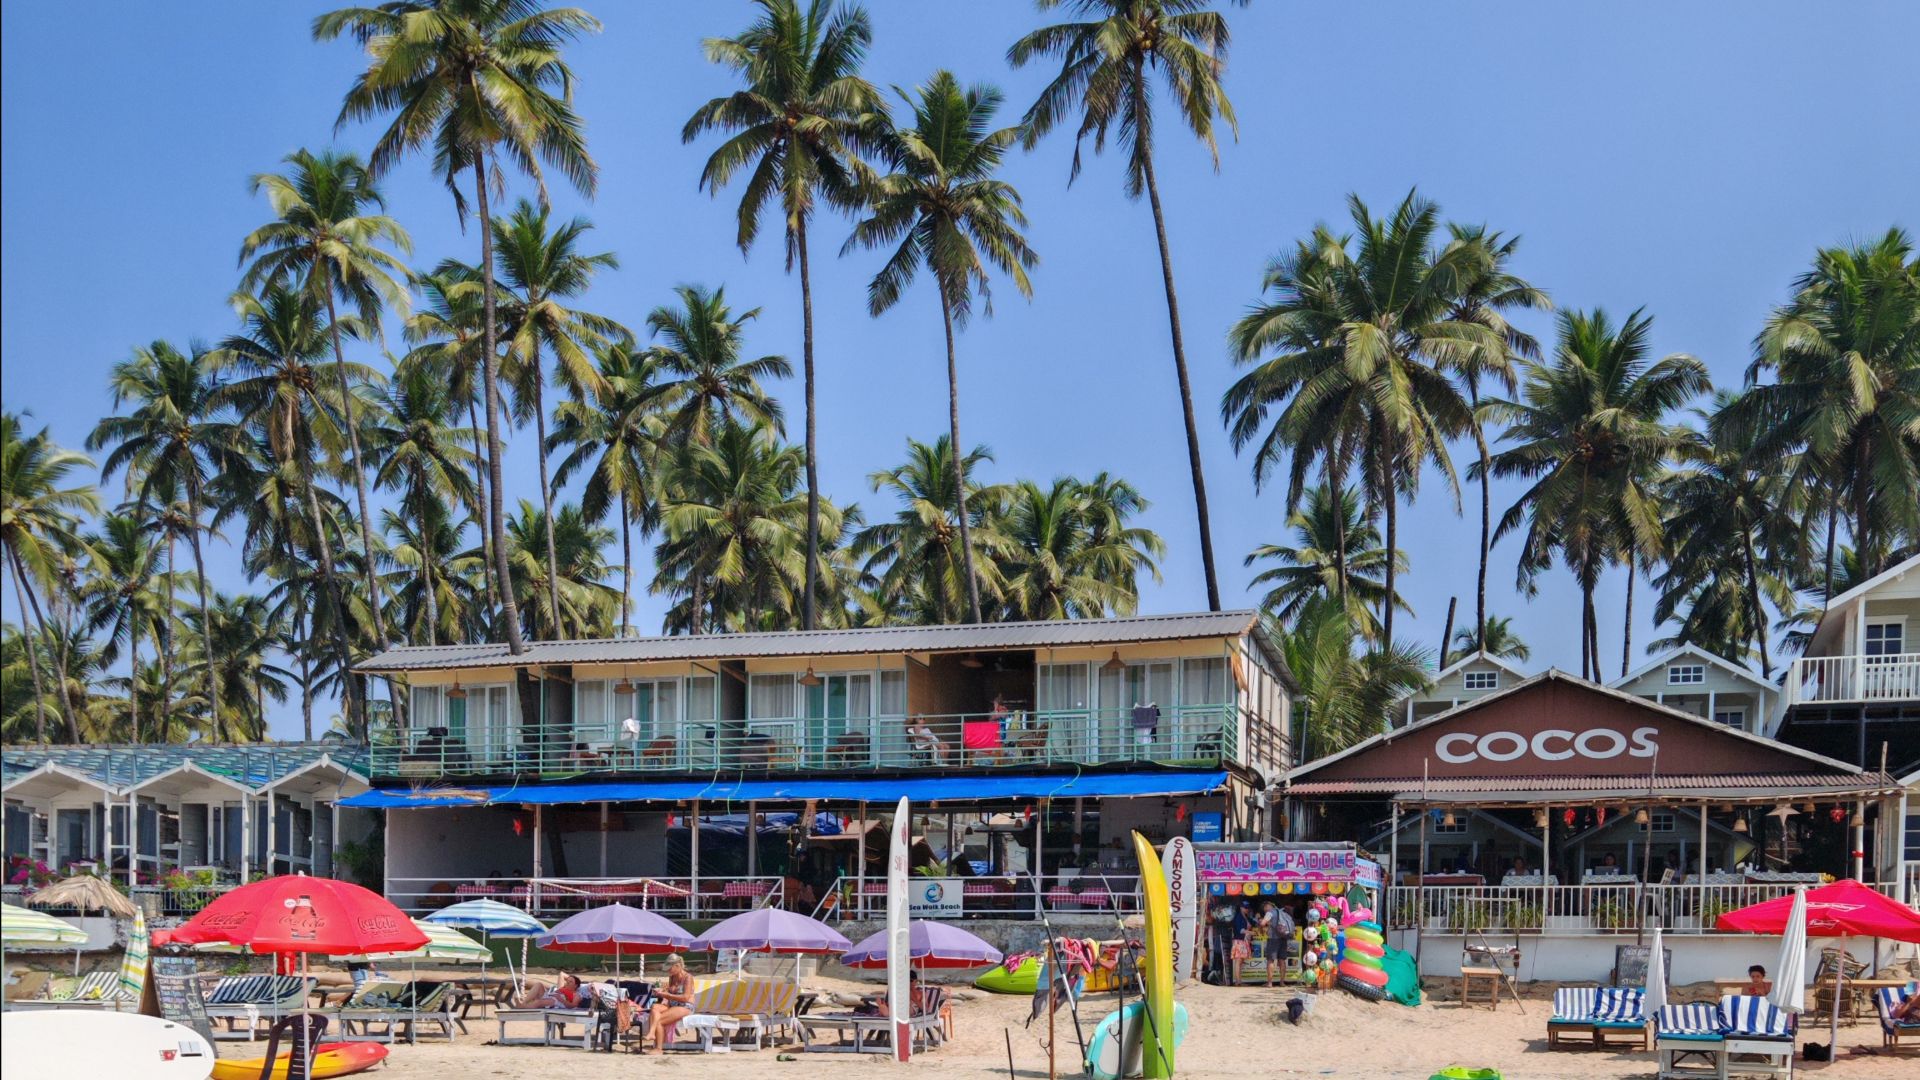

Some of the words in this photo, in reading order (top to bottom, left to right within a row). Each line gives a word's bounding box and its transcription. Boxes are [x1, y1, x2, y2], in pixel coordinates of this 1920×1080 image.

[1435, 726, 1659, 764] COCOS
[1197, 852, 1251, 869] STAND
[1257, 852, 1279, 869] UP
[1285, 852, 1355, 869] PADDLE
